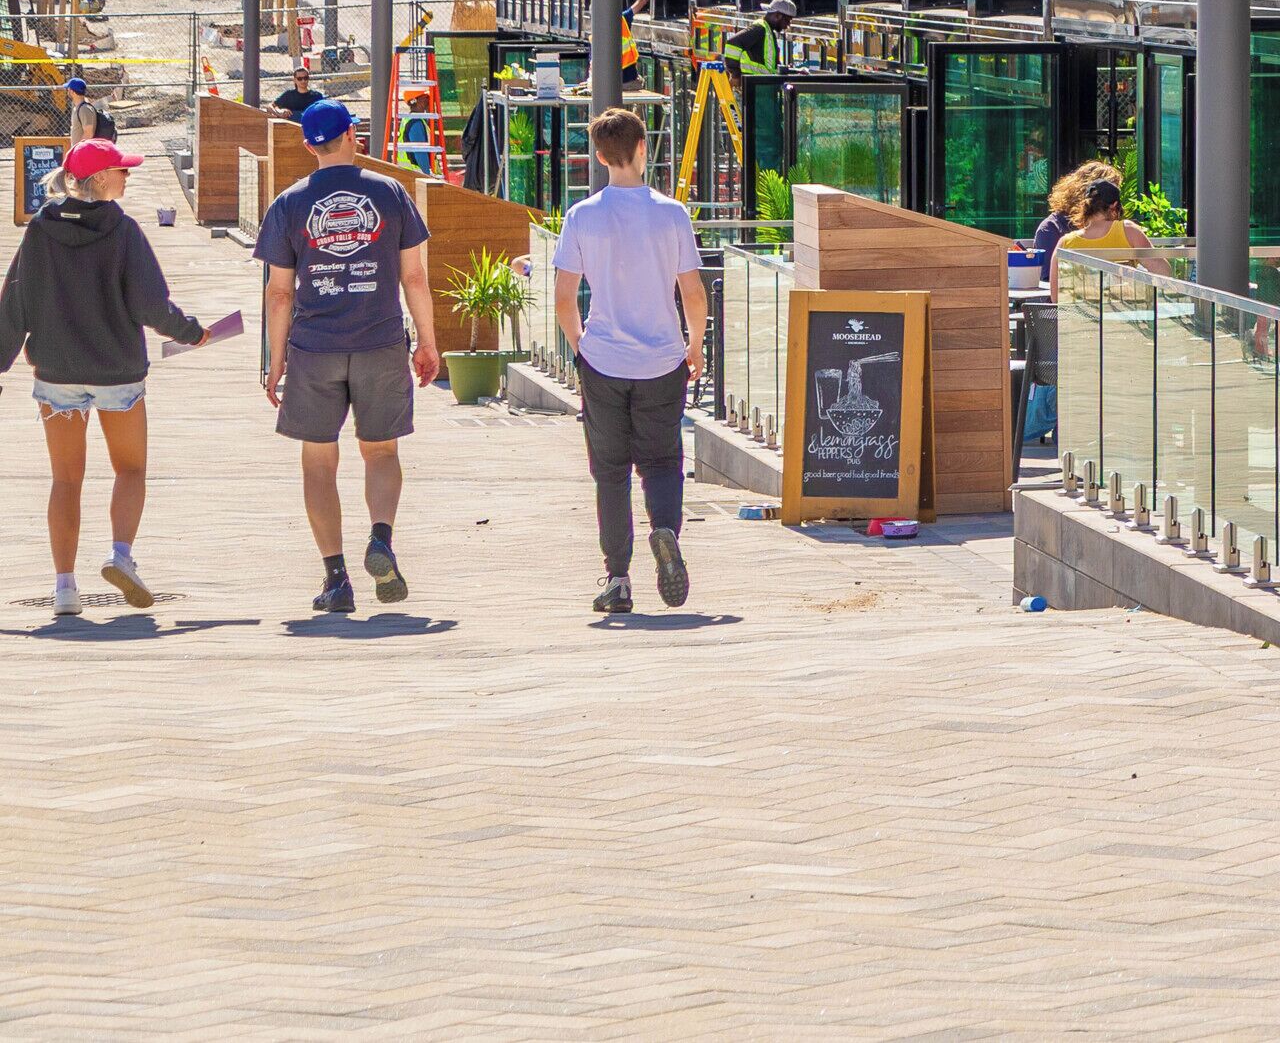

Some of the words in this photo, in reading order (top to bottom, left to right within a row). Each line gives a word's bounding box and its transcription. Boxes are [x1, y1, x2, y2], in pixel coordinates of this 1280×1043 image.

[336, 233, 352, 242] FALLS
[832, 333, 881, 341] MOOSEHEAD
[820, 426, 899, 459] lemongrass
[818, 447, 852, 460] PEPPERS
[804, 469, 821, 482] good
[836, 470, 852, 482] good
[864, 470, 879, 482] good
